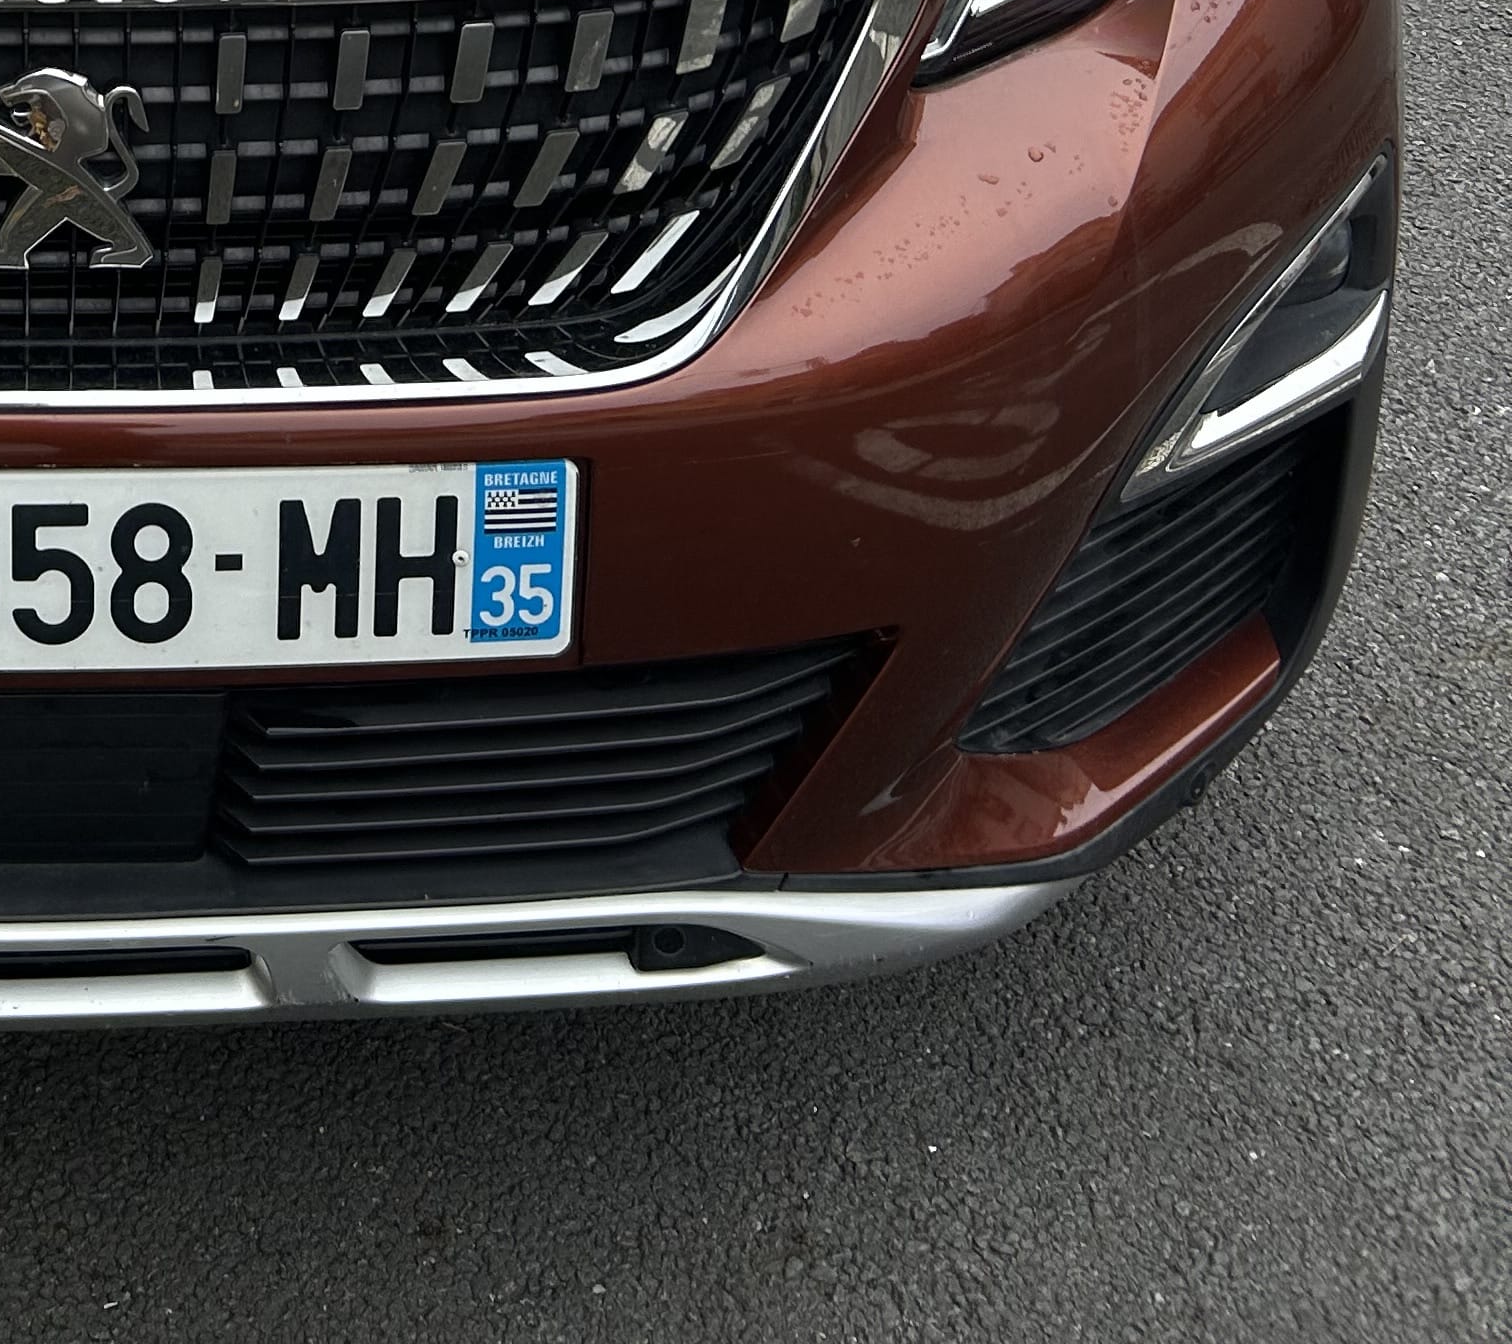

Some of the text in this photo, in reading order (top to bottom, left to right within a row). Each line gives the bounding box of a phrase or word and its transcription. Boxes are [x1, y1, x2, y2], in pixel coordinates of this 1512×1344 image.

[484, 471, 558, 486] BRETAGNE
[493, 535, 545, 549] BREIZH
[479, 563, 554, 627] 35
[463, 628, 498, 639] TPPR
